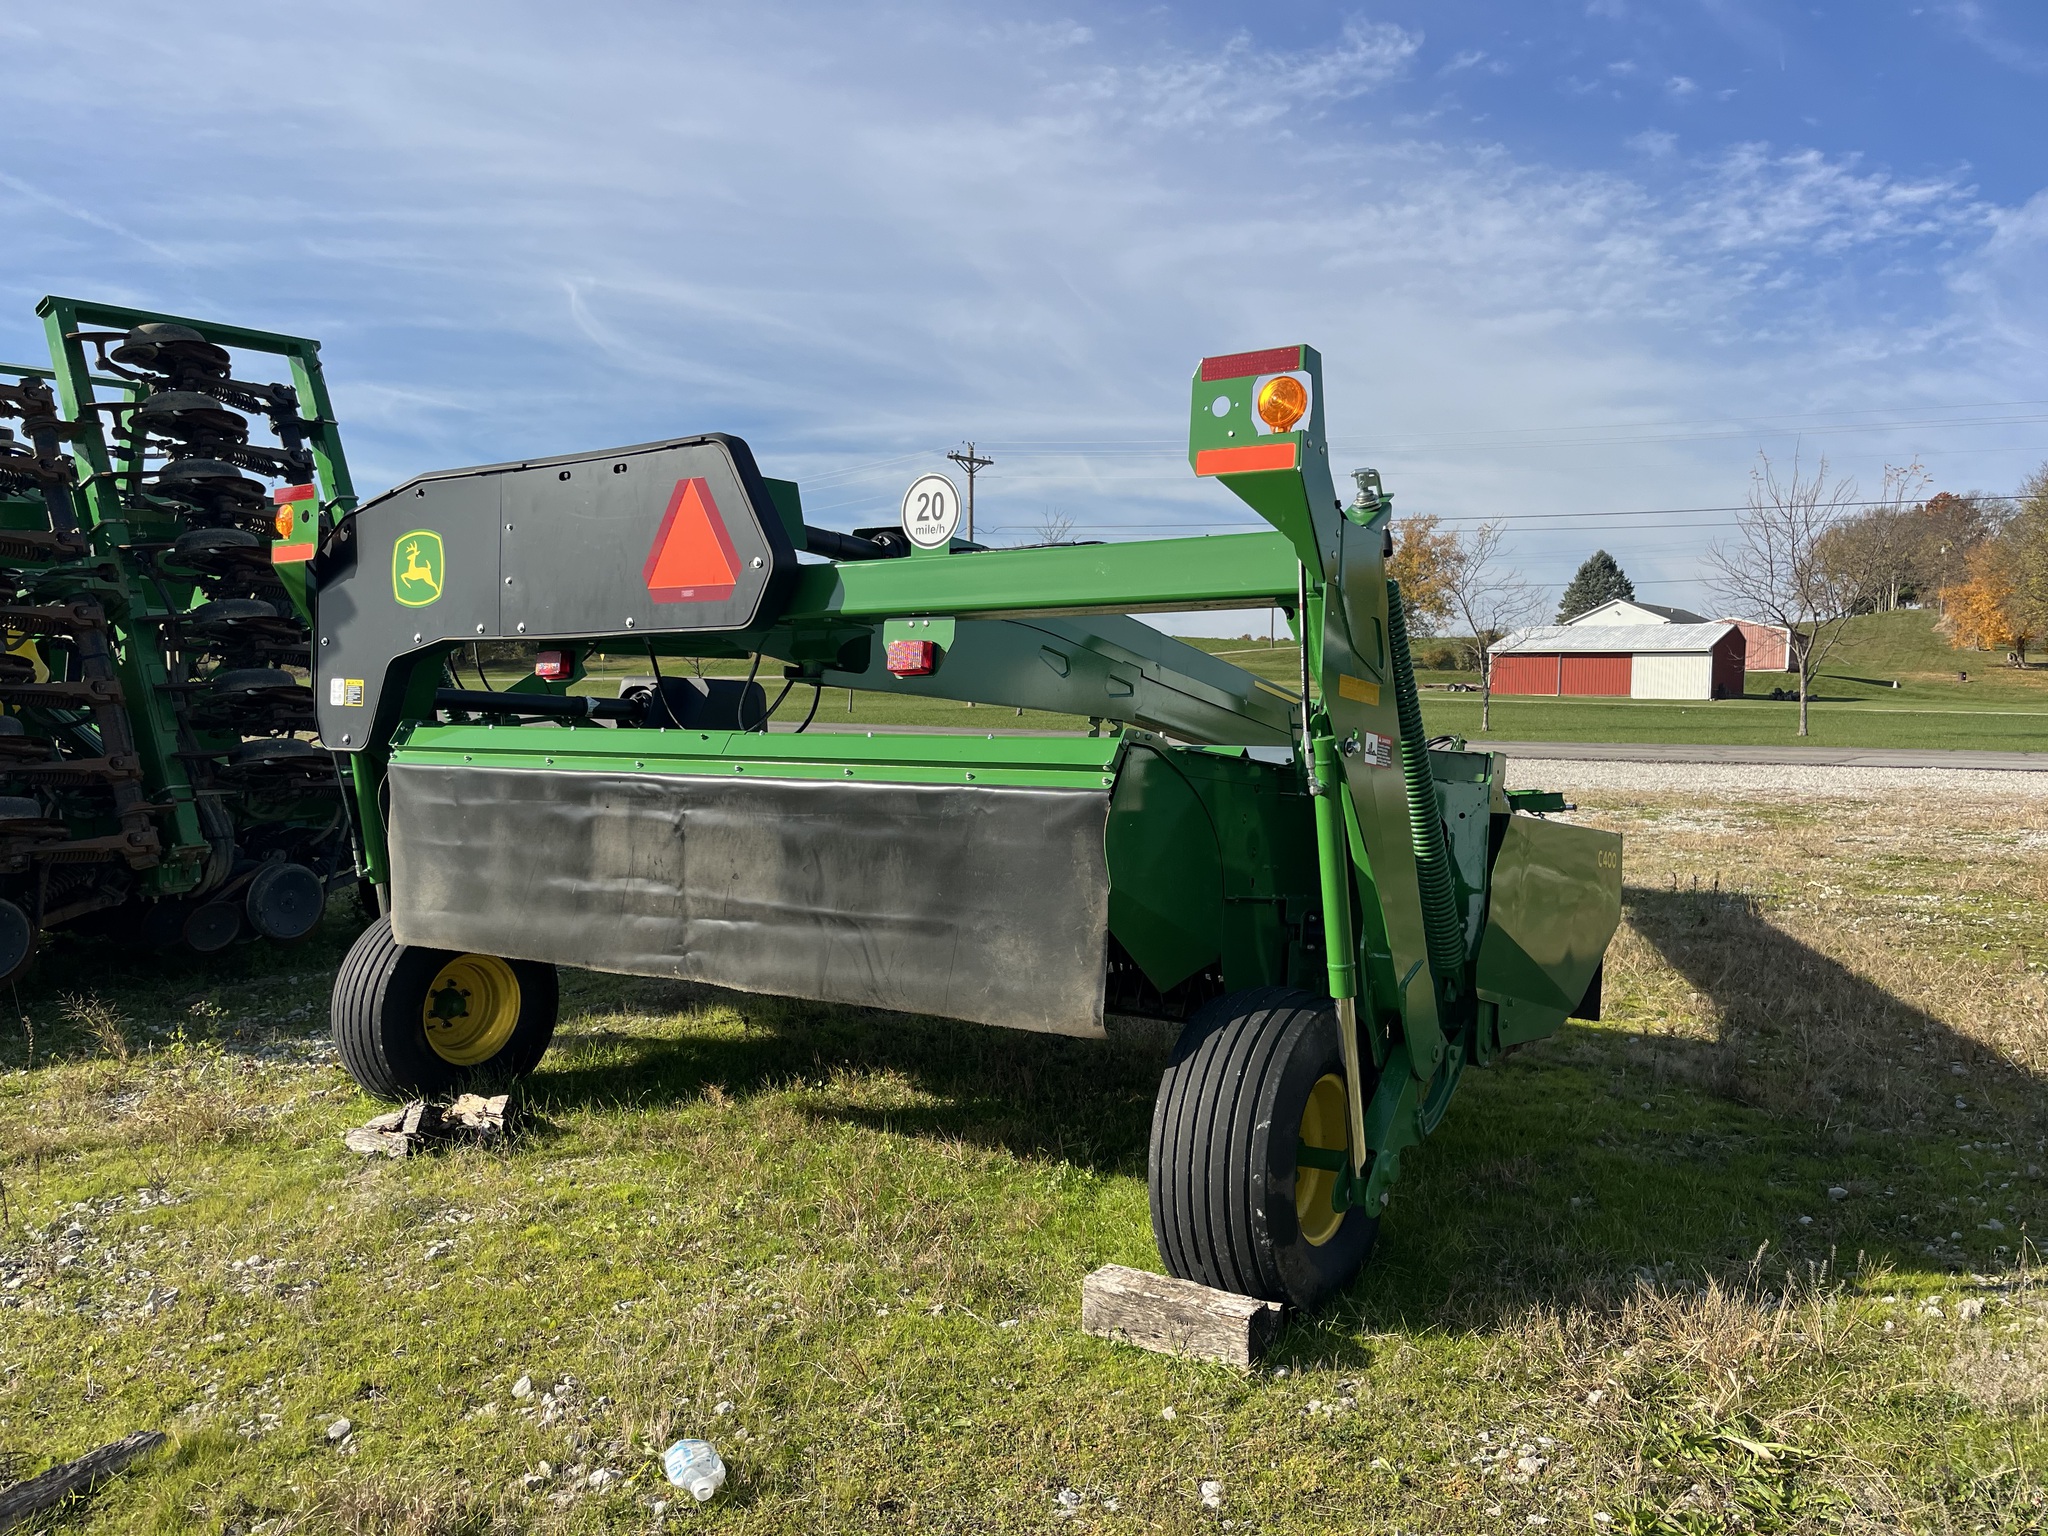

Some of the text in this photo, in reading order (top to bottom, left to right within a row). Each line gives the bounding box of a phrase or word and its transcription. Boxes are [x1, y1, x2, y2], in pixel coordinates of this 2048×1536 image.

[916, 491, 945, 522] 20
[915, 523, 946, 535] mile/h
[1597, 849, 1617, 869] C400
